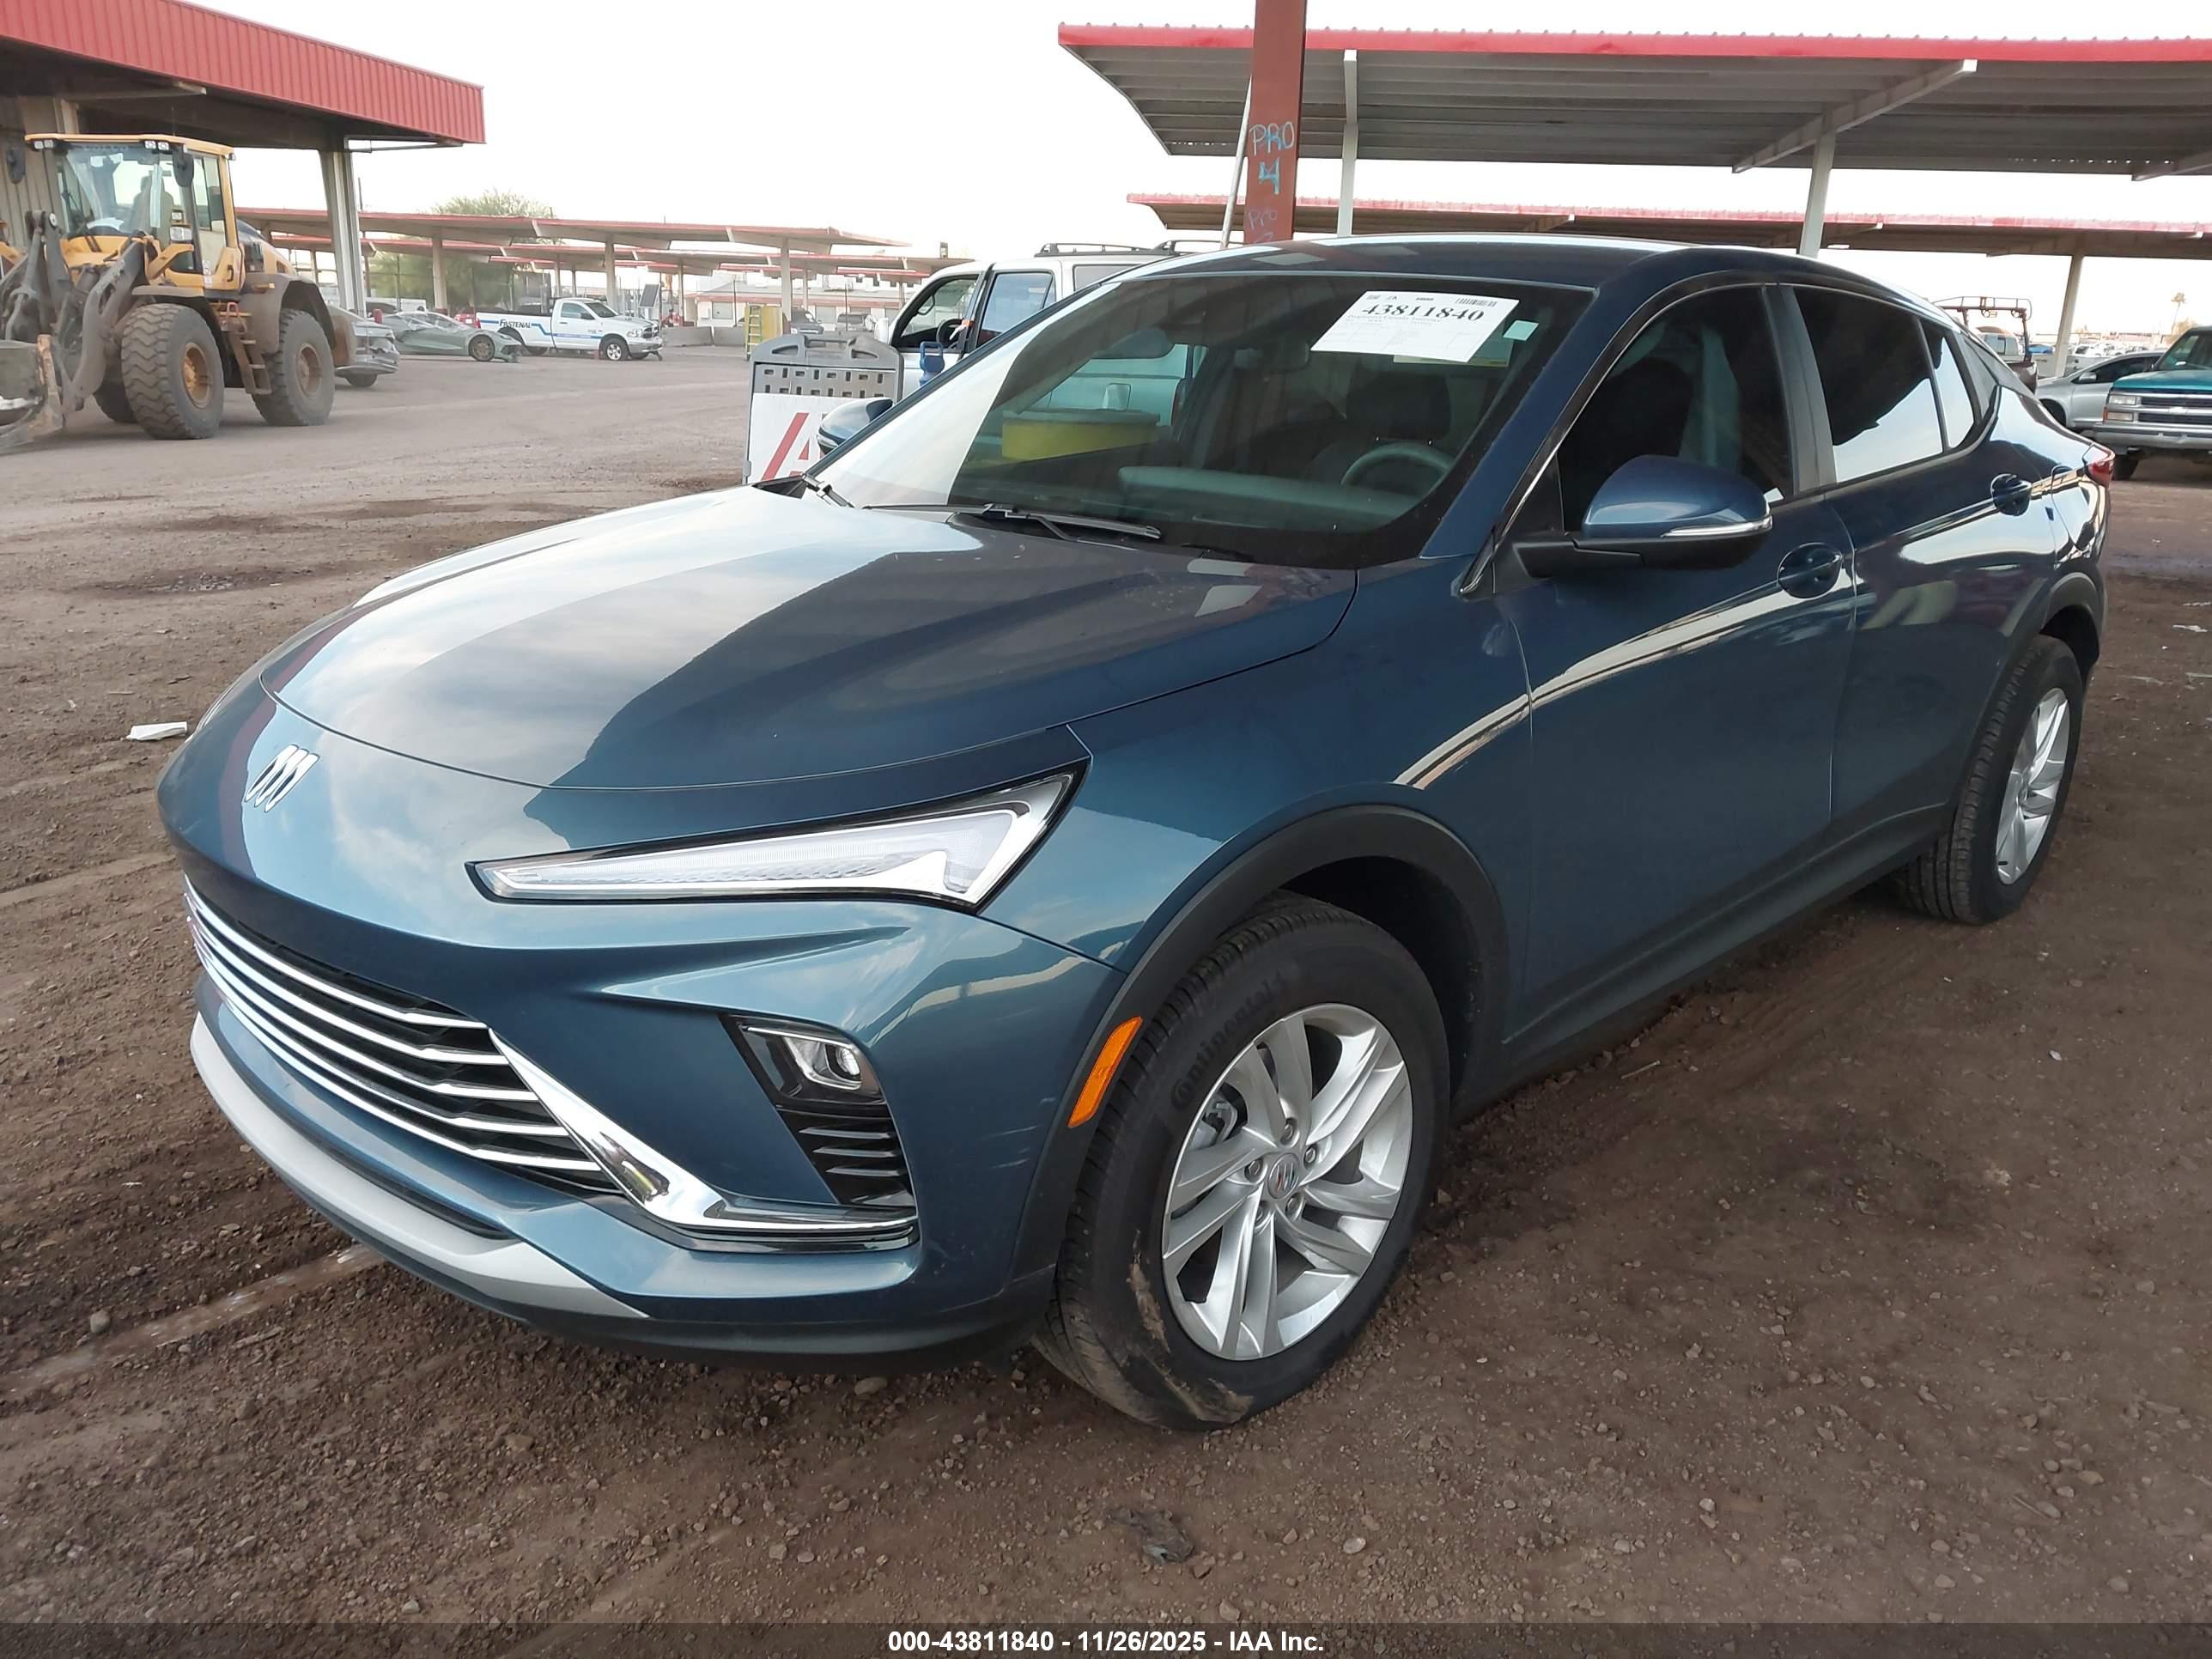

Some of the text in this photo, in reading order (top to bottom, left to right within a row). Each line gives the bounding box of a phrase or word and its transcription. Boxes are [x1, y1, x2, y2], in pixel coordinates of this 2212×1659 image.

[1249, 121, 1295, 156] PRO
[1258, 156, 1279, 195] 4
[1362, 303, 1485, 322] 43811840
